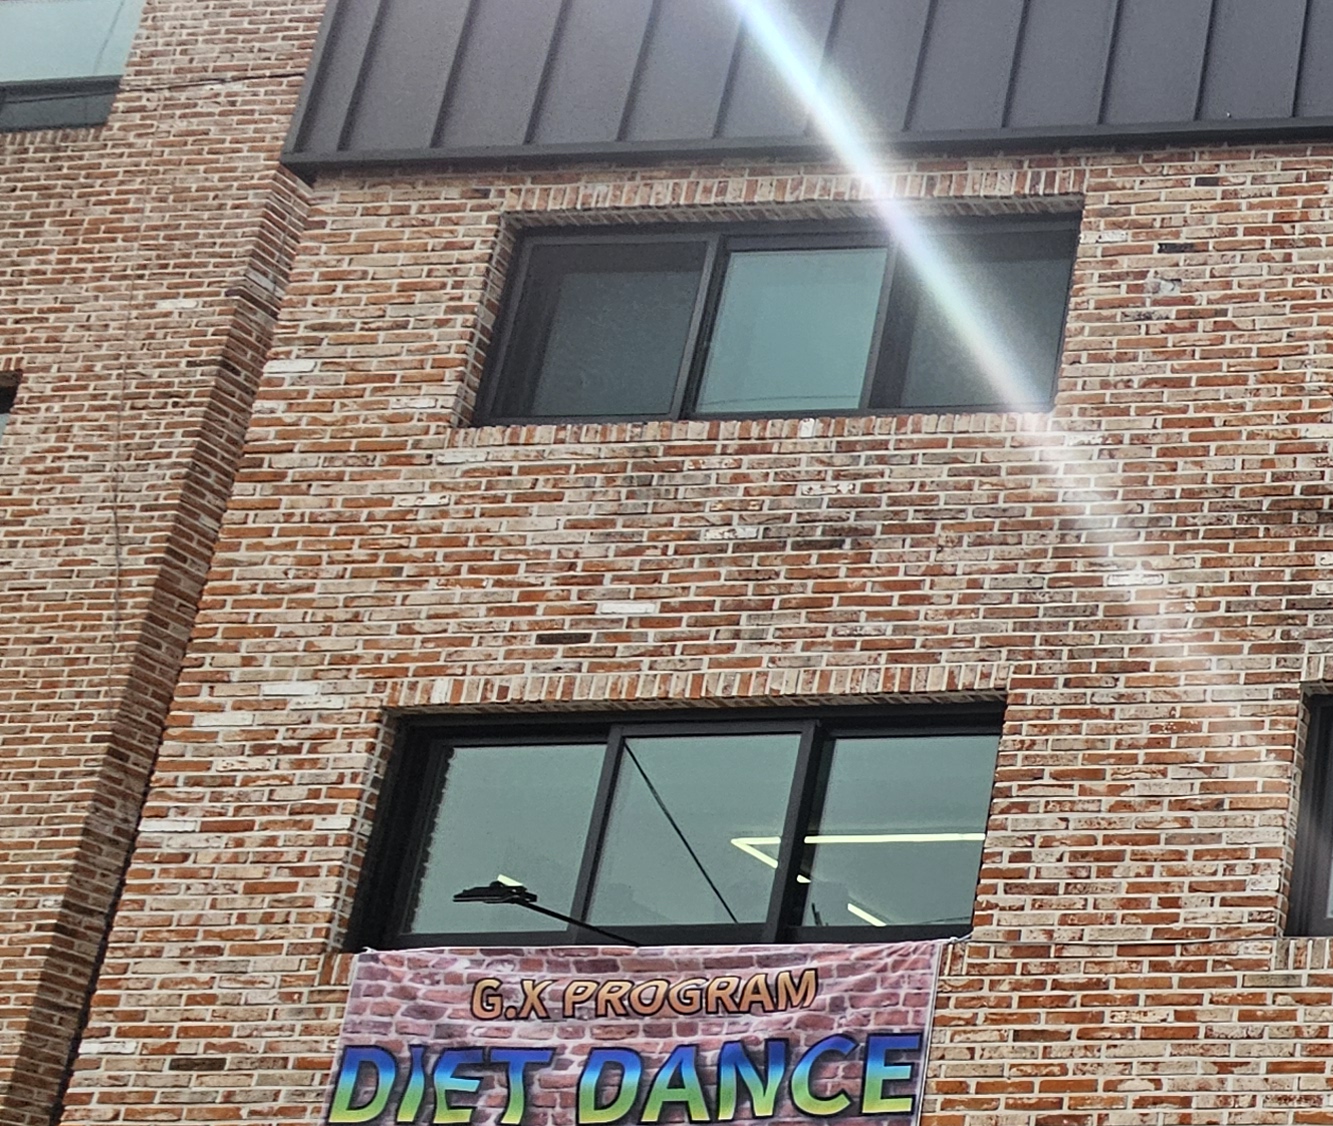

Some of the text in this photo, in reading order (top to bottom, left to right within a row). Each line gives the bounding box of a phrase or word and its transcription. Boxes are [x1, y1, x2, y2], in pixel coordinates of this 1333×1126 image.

[471, 968, 819, 1020] G.X PROGRAM
[326, 1031, 923, 1126] DIET DANCE
